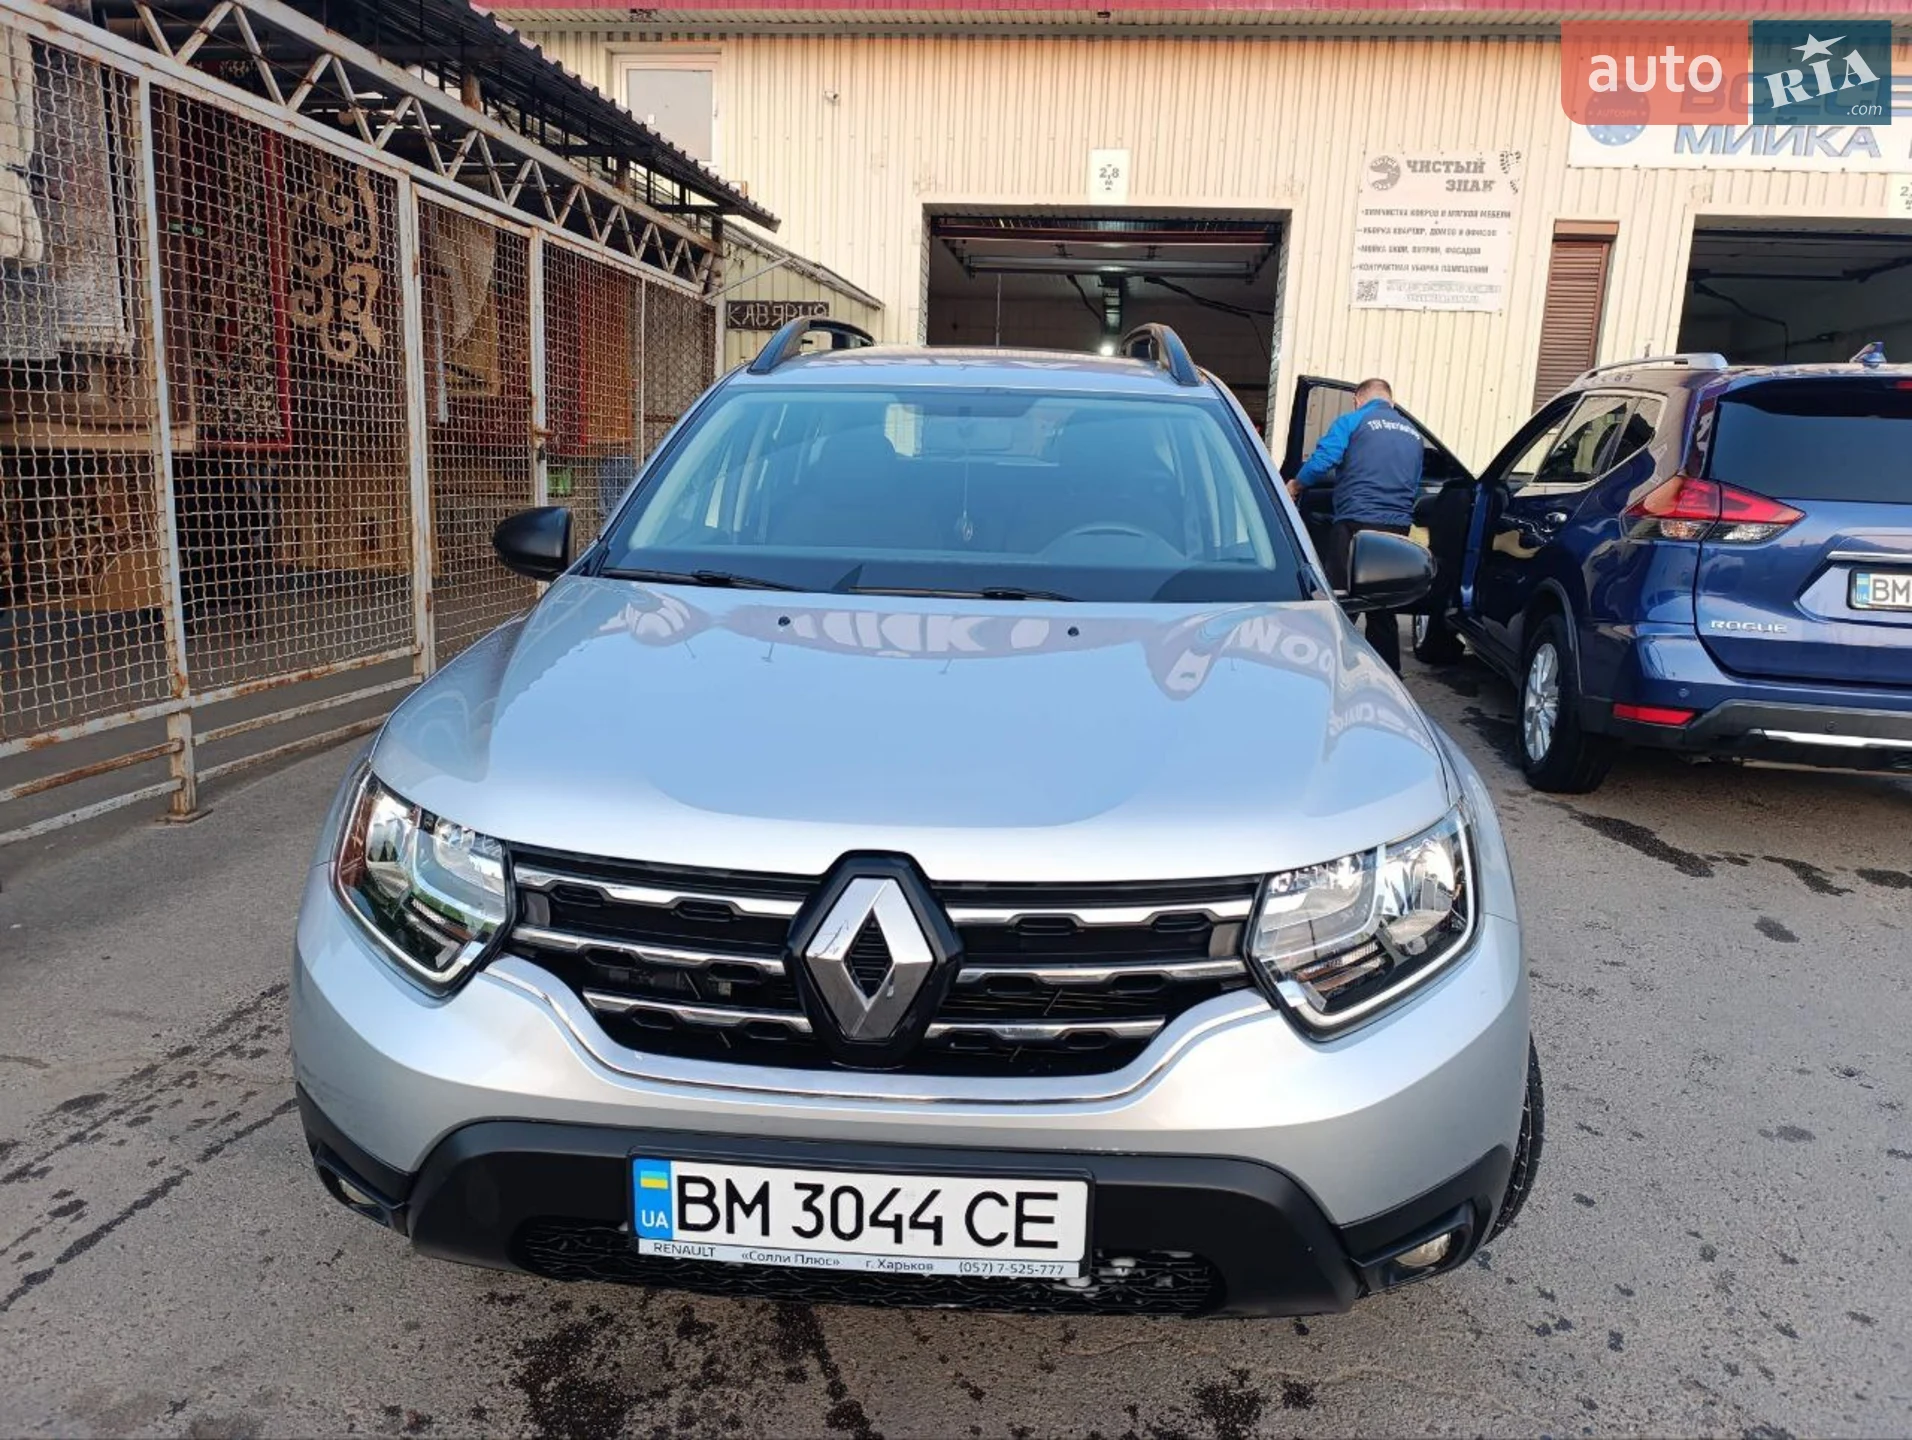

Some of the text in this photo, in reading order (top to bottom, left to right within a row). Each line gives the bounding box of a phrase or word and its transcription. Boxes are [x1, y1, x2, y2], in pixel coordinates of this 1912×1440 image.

[1674, 117, 1882, 158] МИЙКА
[1099, 167, 1120, 180] 2,8
[1406, 157, 1486, 174] ЧИСТЫЙ
[1445, 178, 1496, 193] ЗНАК
[1711, 619, 1788, 634] ROGUE
[641, 1174, 1059, 1249] UA BM 3044 CE
[653, 1241, 716, 1258] RENAULT
[741, 1250, 841, 1267] «Солли Плюс»
[877, 1258, 934, 1273] Харьков
[958, 1261, 1065, 1276] (057) 7-525-777
